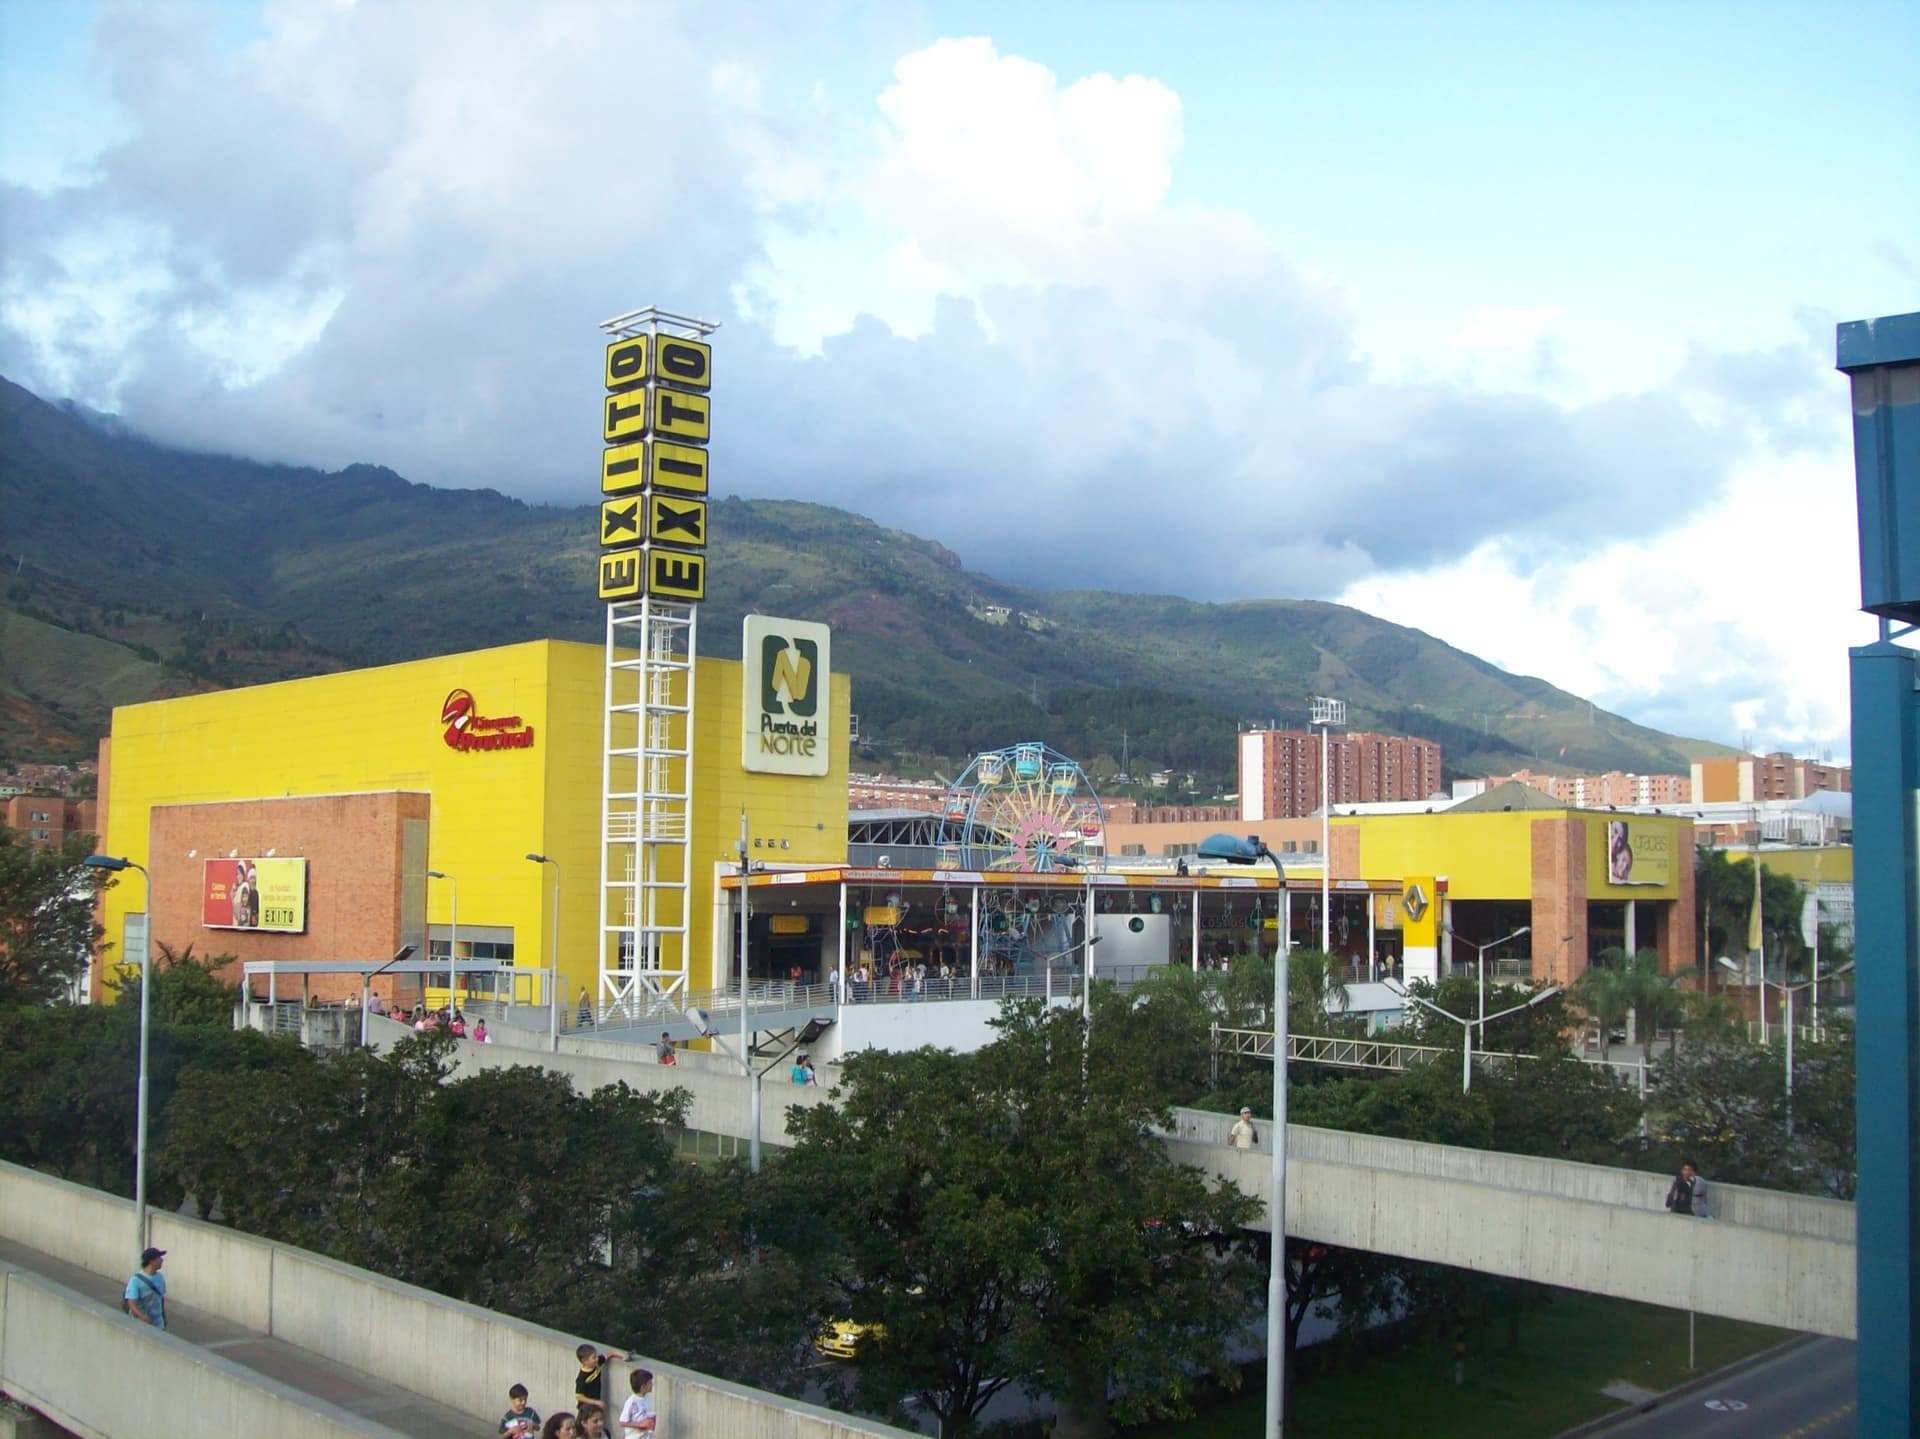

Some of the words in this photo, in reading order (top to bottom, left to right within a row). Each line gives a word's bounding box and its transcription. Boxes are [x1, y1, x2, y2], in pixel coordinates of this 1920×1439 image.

[603, 344, 643, 591] EXITO
[655, 343, 705, 590] EXITO
[761, 713, 799, 735] Puerta
[800, 720, 817, 737] del
[265, 909, 294, 924] EXITO
